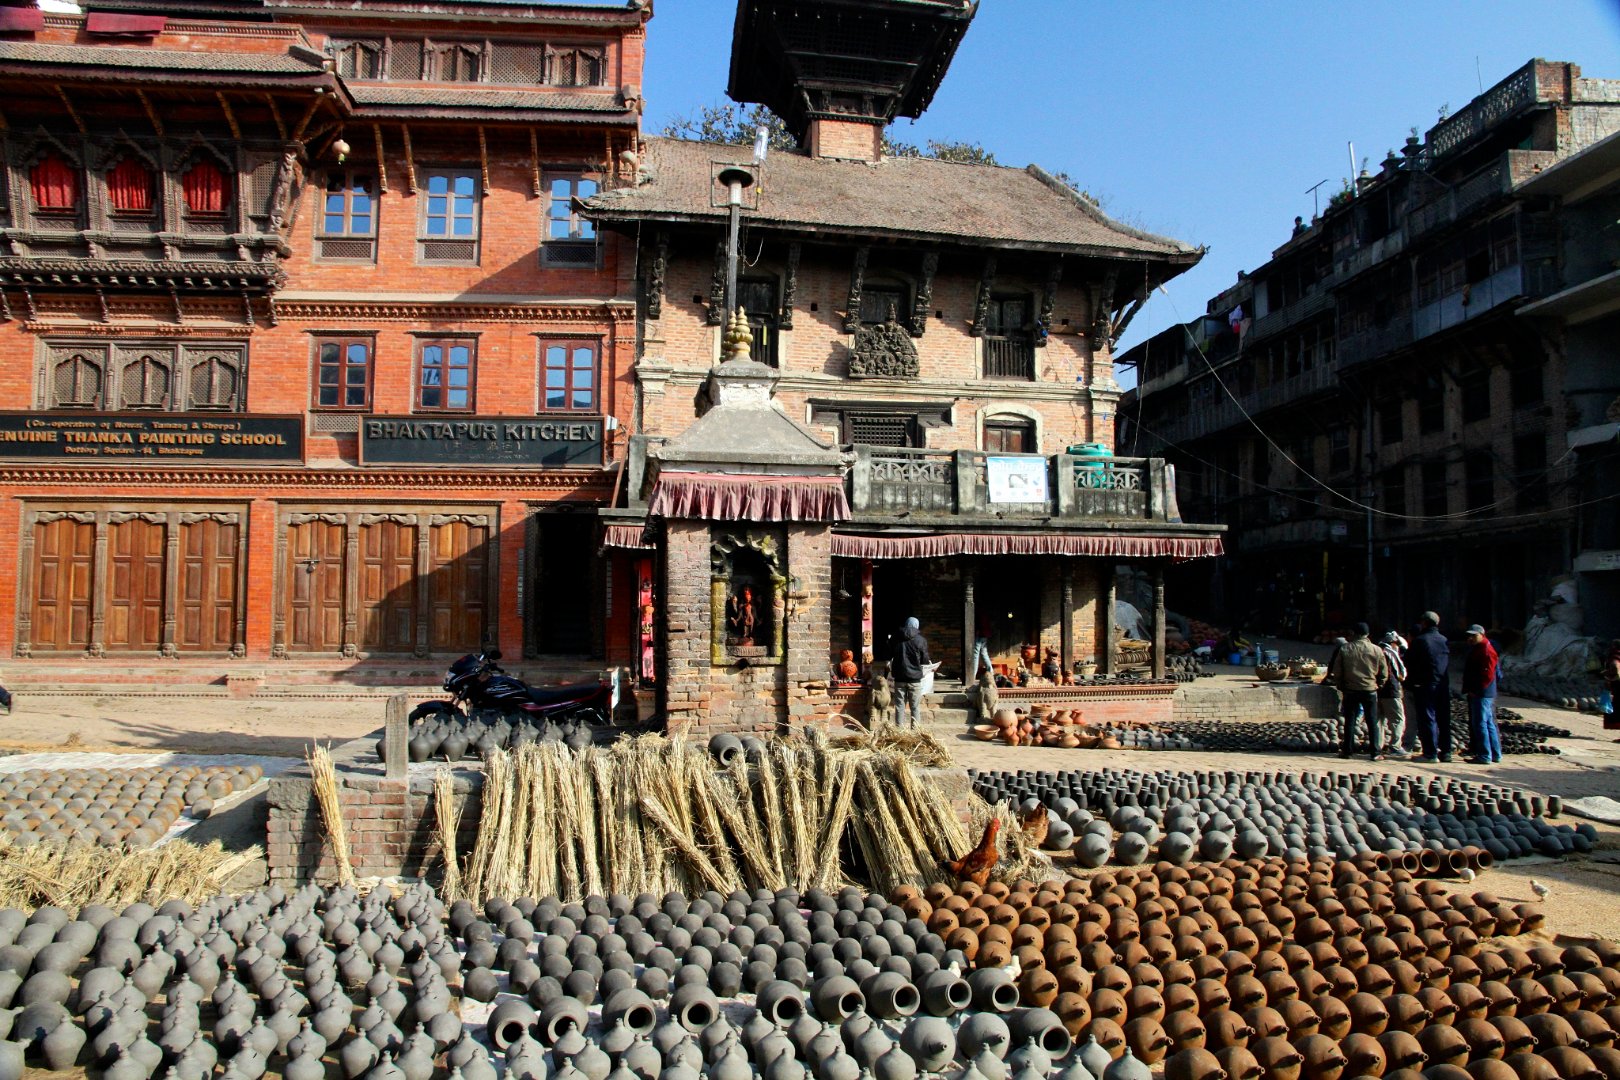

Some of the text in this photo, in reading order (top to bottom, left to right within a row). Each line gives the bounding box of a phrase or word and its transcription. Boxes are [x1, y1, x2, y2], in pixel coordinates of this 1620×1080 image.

[100, 422, 111, 430] of
[152, 421, 188, 431] Tamang
[191, 422, 200, 430] &
[367, 421, 596, 441] BHAKTAPUR KITCHEN
[64, 431, 133, 443] THANKA
[139, 432, 215, 444] PAINTING
[220, 433, 286, 445] SCHOOL
[64, 446, 98, 454] Pottery
[158, 447, 204, 456] Bhaktapur
